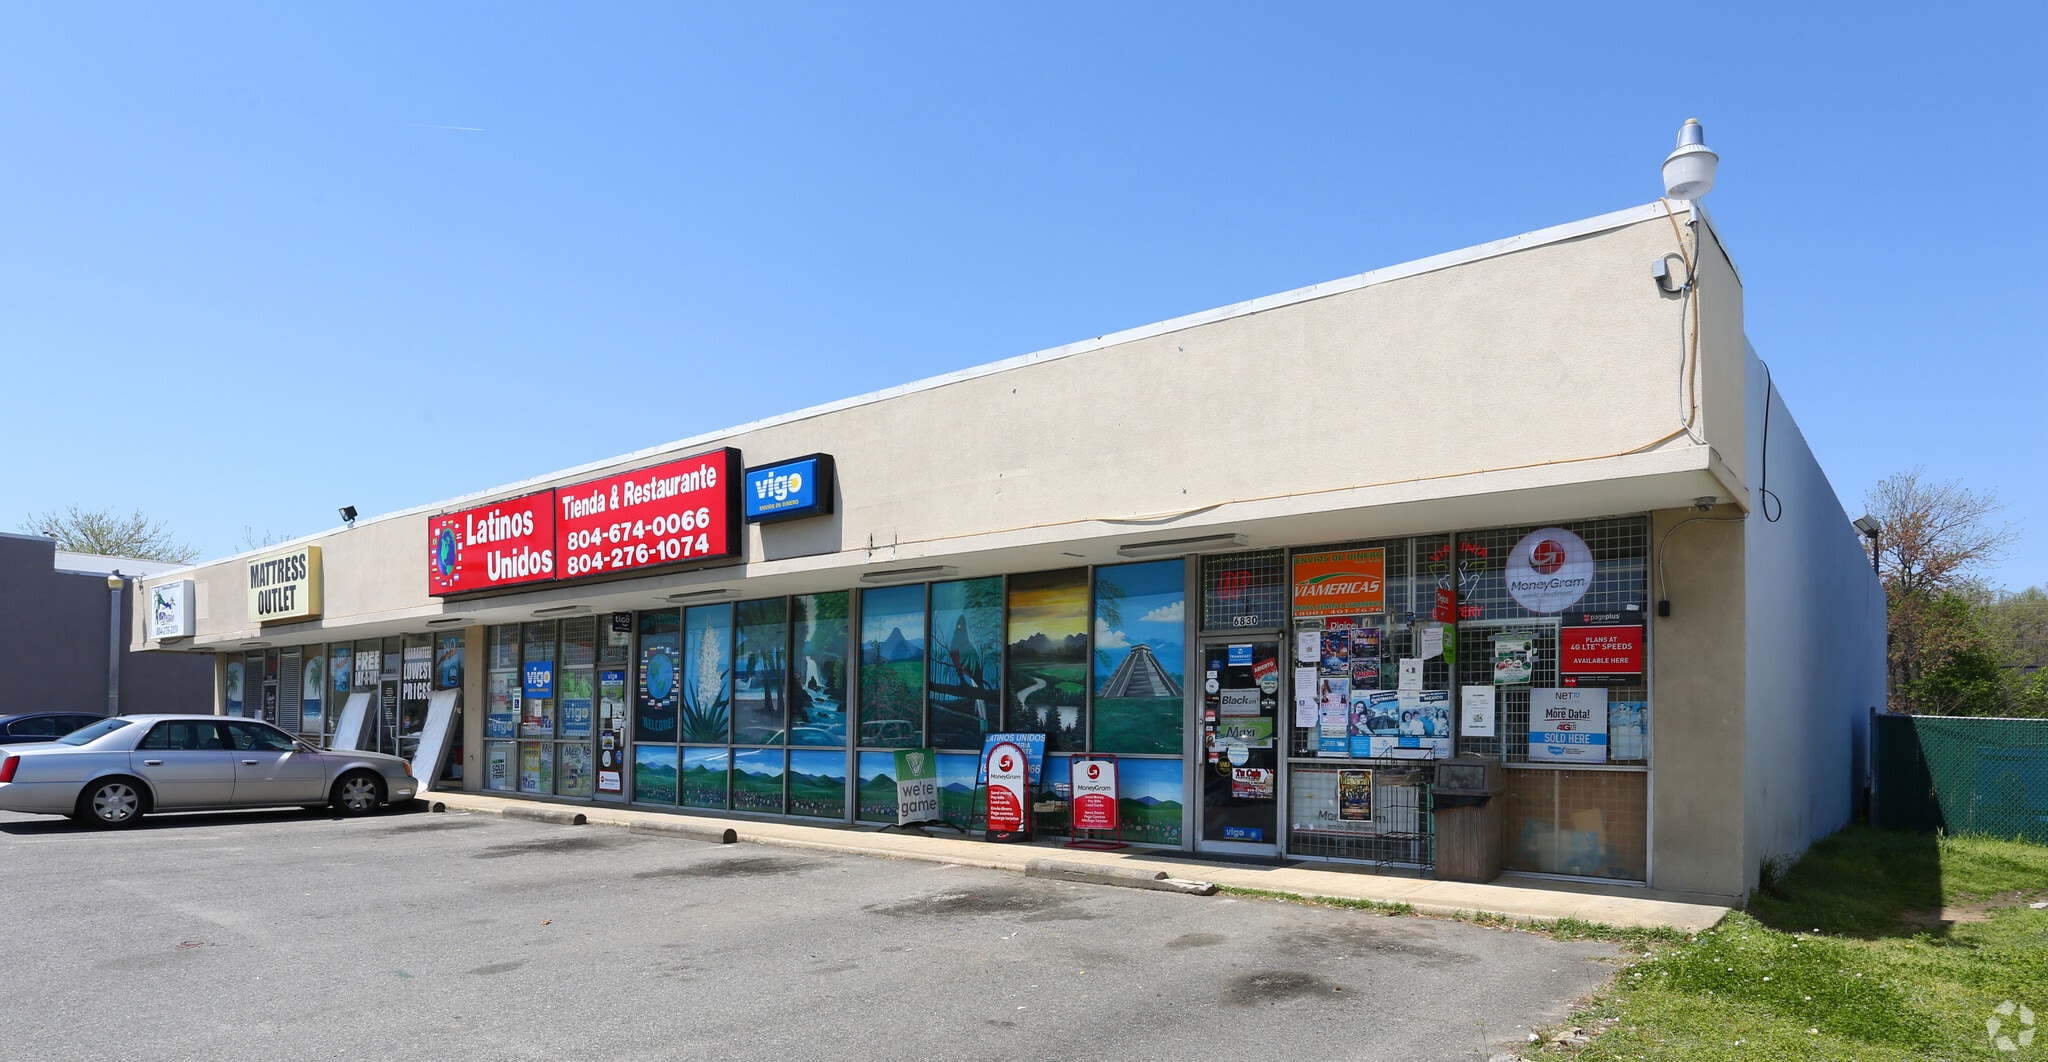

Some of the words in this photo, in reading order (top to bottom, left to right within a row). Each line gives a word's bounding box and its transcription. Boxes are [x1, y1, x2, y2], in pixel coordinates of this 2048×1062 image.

[562, 489, 606, 520] Tienda
[609, 484, 619, 511] &
[623, 463, 717, 508] Restaurante
[755, 471, 802, 501] vigo
[466, 508, 534, 546] Latinos
[567, 507, 710, 551] 804-674-0066
[567, 533, 710, 575] 804-276-1074
[1332, 554, 1343, 562] DE
[1347, 551, 1384, 561] DINERO
[1430, 542, 1488, 562] VIRINIA
[250, 553, 307, 589] MATTRESS
[487, 546, 553, 582] Unidos
[1294, 580, 1381, 598] VIAMERICAS
[1511, 578, 1585, 592] MoneyGram
[258, 584, 297, 616] OUTLET
[1431, 605, 1484, 618] LERY
[1590, 613, 1620, 621] pageplus
[1233, 616, 1258, 626] 6830
[1570, 643, 1581, 651] 4G
[356, 650, 380, 670] FREE
[1254, 661, 1274, 673] ABIERTO
[403, 661, 431, 681] LOWEST
[526, 666, 551, 688] vigo
[402, 682, 431, 701] PRICES
[1370, 694, 1397, 703] GUATEMAL
[1222, 696, 1249, 705] Black
[564, 703, 589, 721] vigo
[1545, 709, 1566, 718] More
[1568, 709, 1590, 719] Data!
[491, 719, 513, 734] vigo
[642, 716, 674, 731] WELCOME!
[1557, 723, 1571, 731] 4G
[985, 734, 1015, 742] LATINOS
[1016, 733, 1046, 741] UNIDOS
[1225, 726, 1255, 739] Maxi
[1544, 733, 1566, 742] SOLD
[1568, 734, 1590, 744] HERE
[902, 781, 934, 797] we're
[901, 799, 937, 817] game
[1226, 828, 1245, 838] vigo
